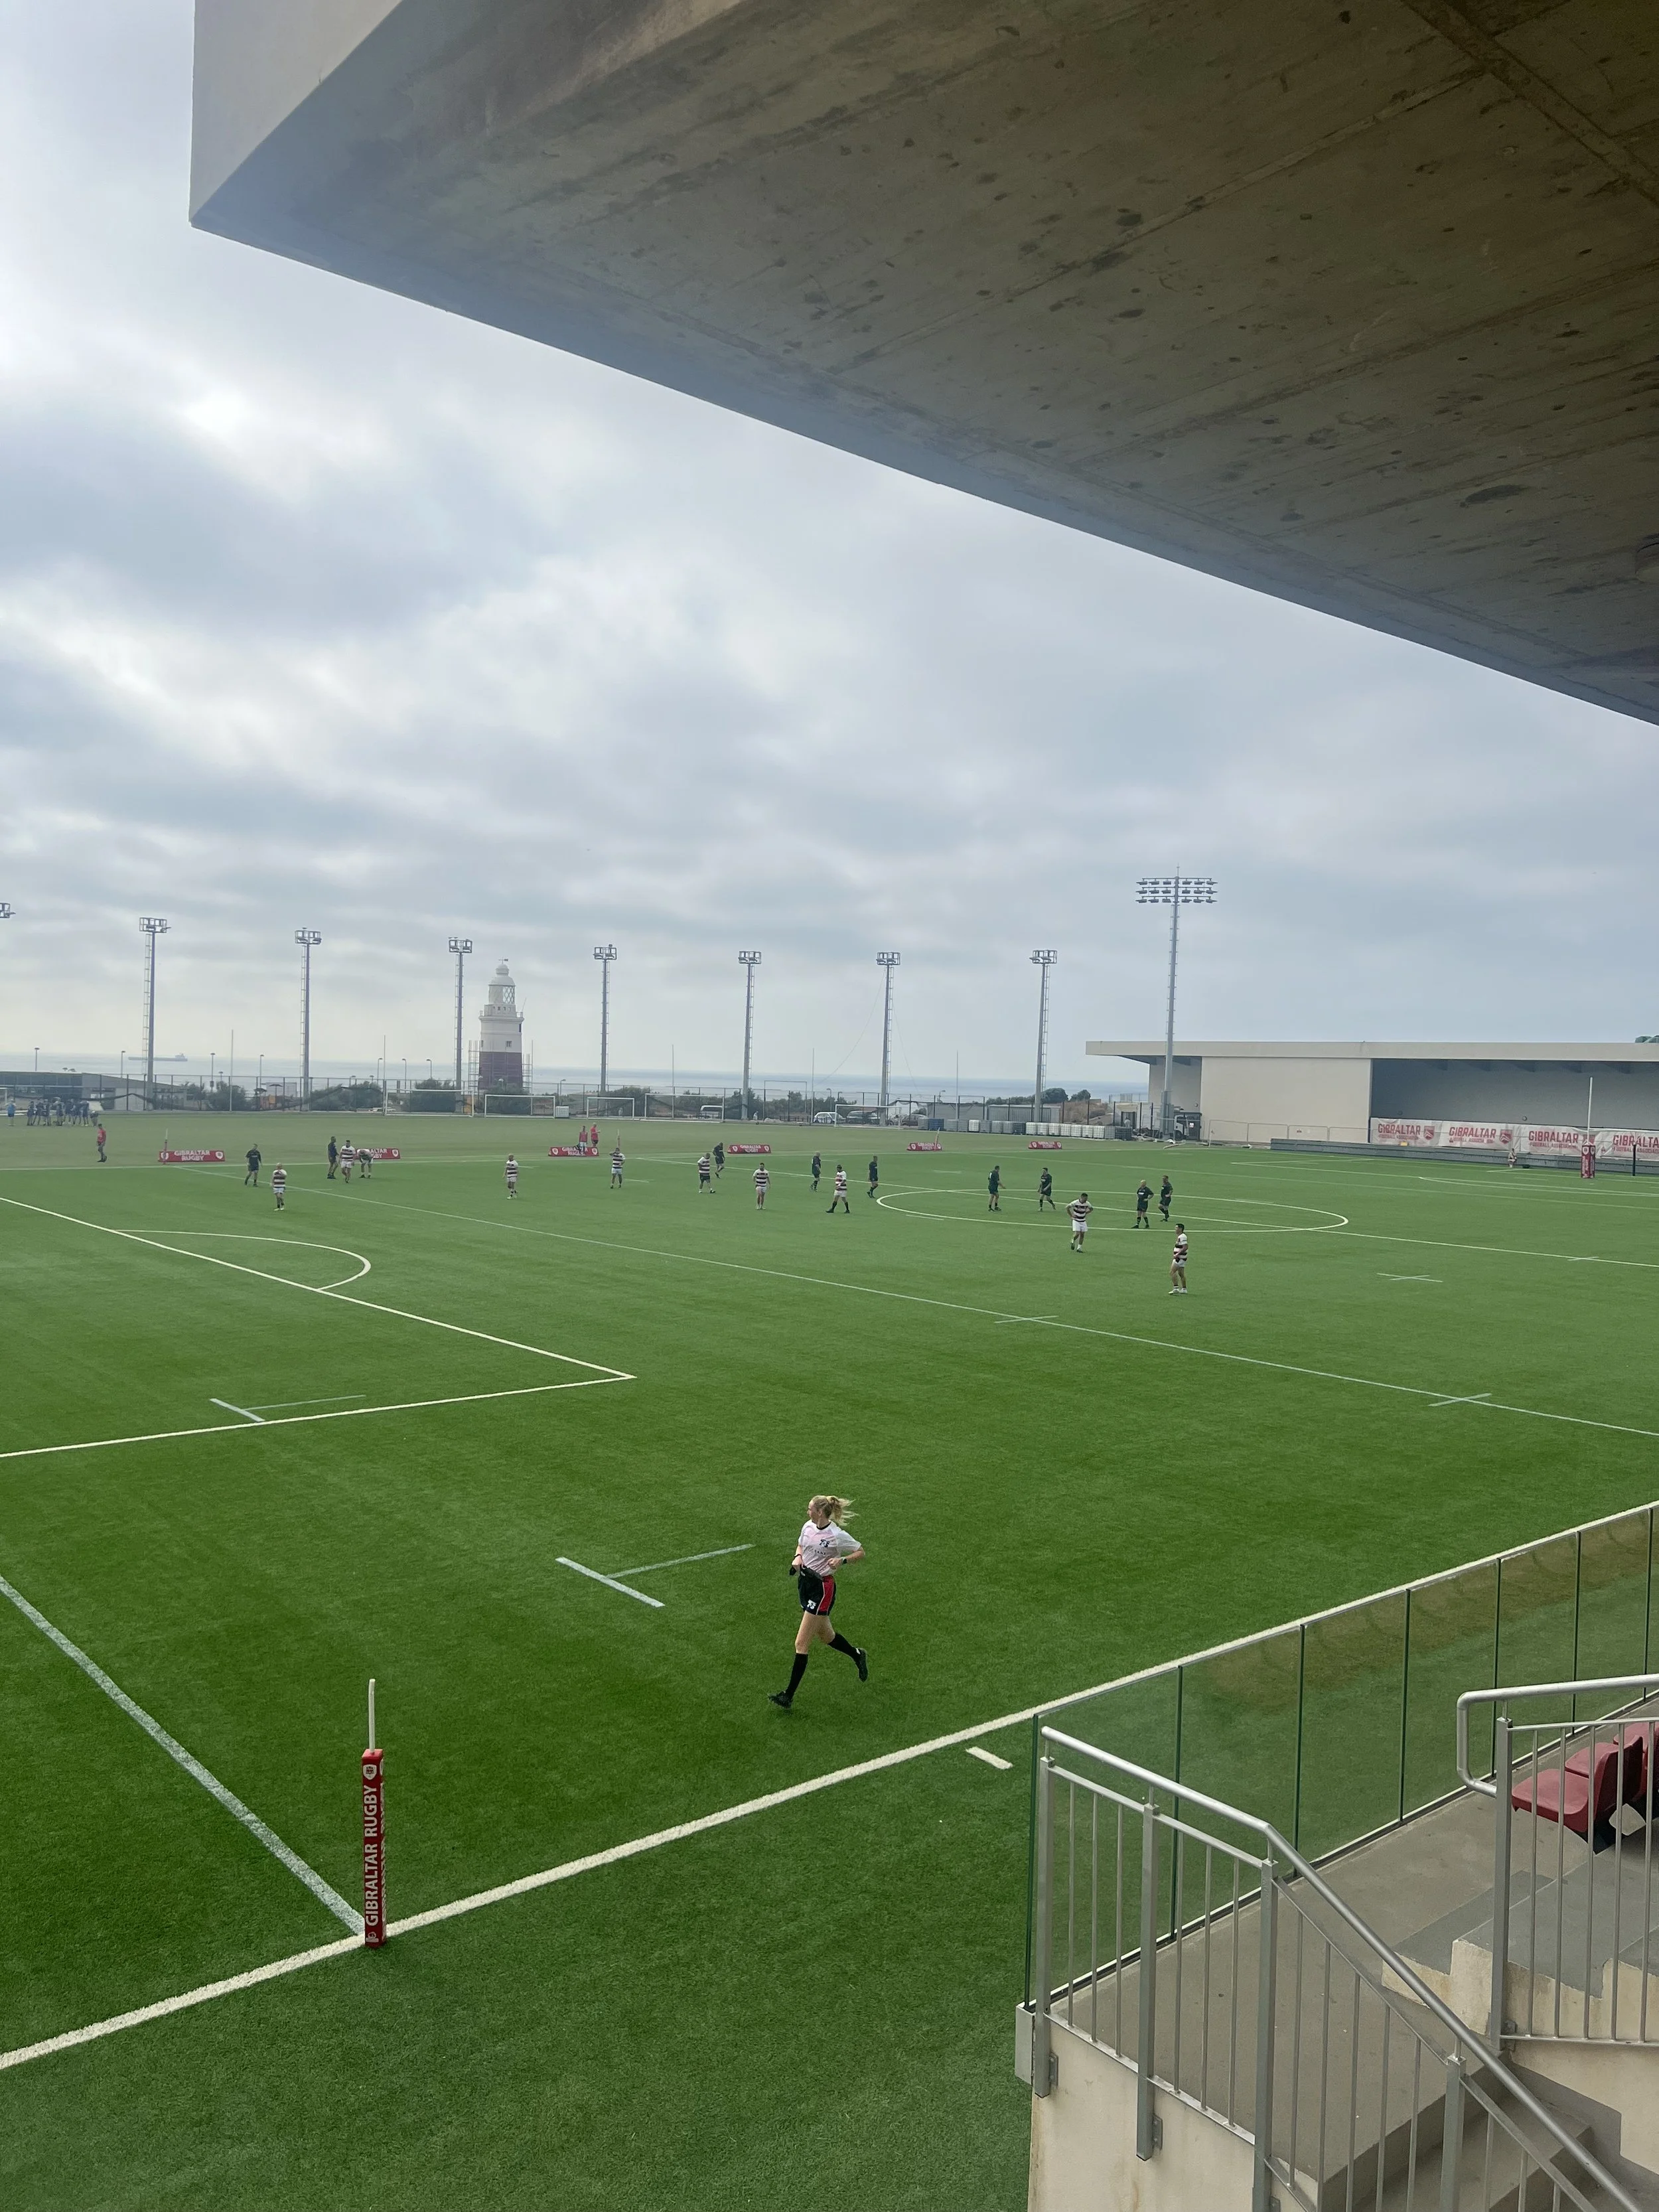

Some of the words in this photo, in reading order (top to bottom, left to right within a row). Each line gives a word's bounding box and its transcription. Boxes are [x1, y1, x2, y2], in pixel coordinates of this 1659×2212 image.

[1378, 1124, 1421, 1135] GIBRALTAR
[1449, 1127, 1496, 1138] GIBRALTAR
[1528, 1131, 1579, 1143] GIBRALTAR
[364, 1785, 378, 1837] RUGBY
[365, 1844, 379, 1926] GIBRALTAR
